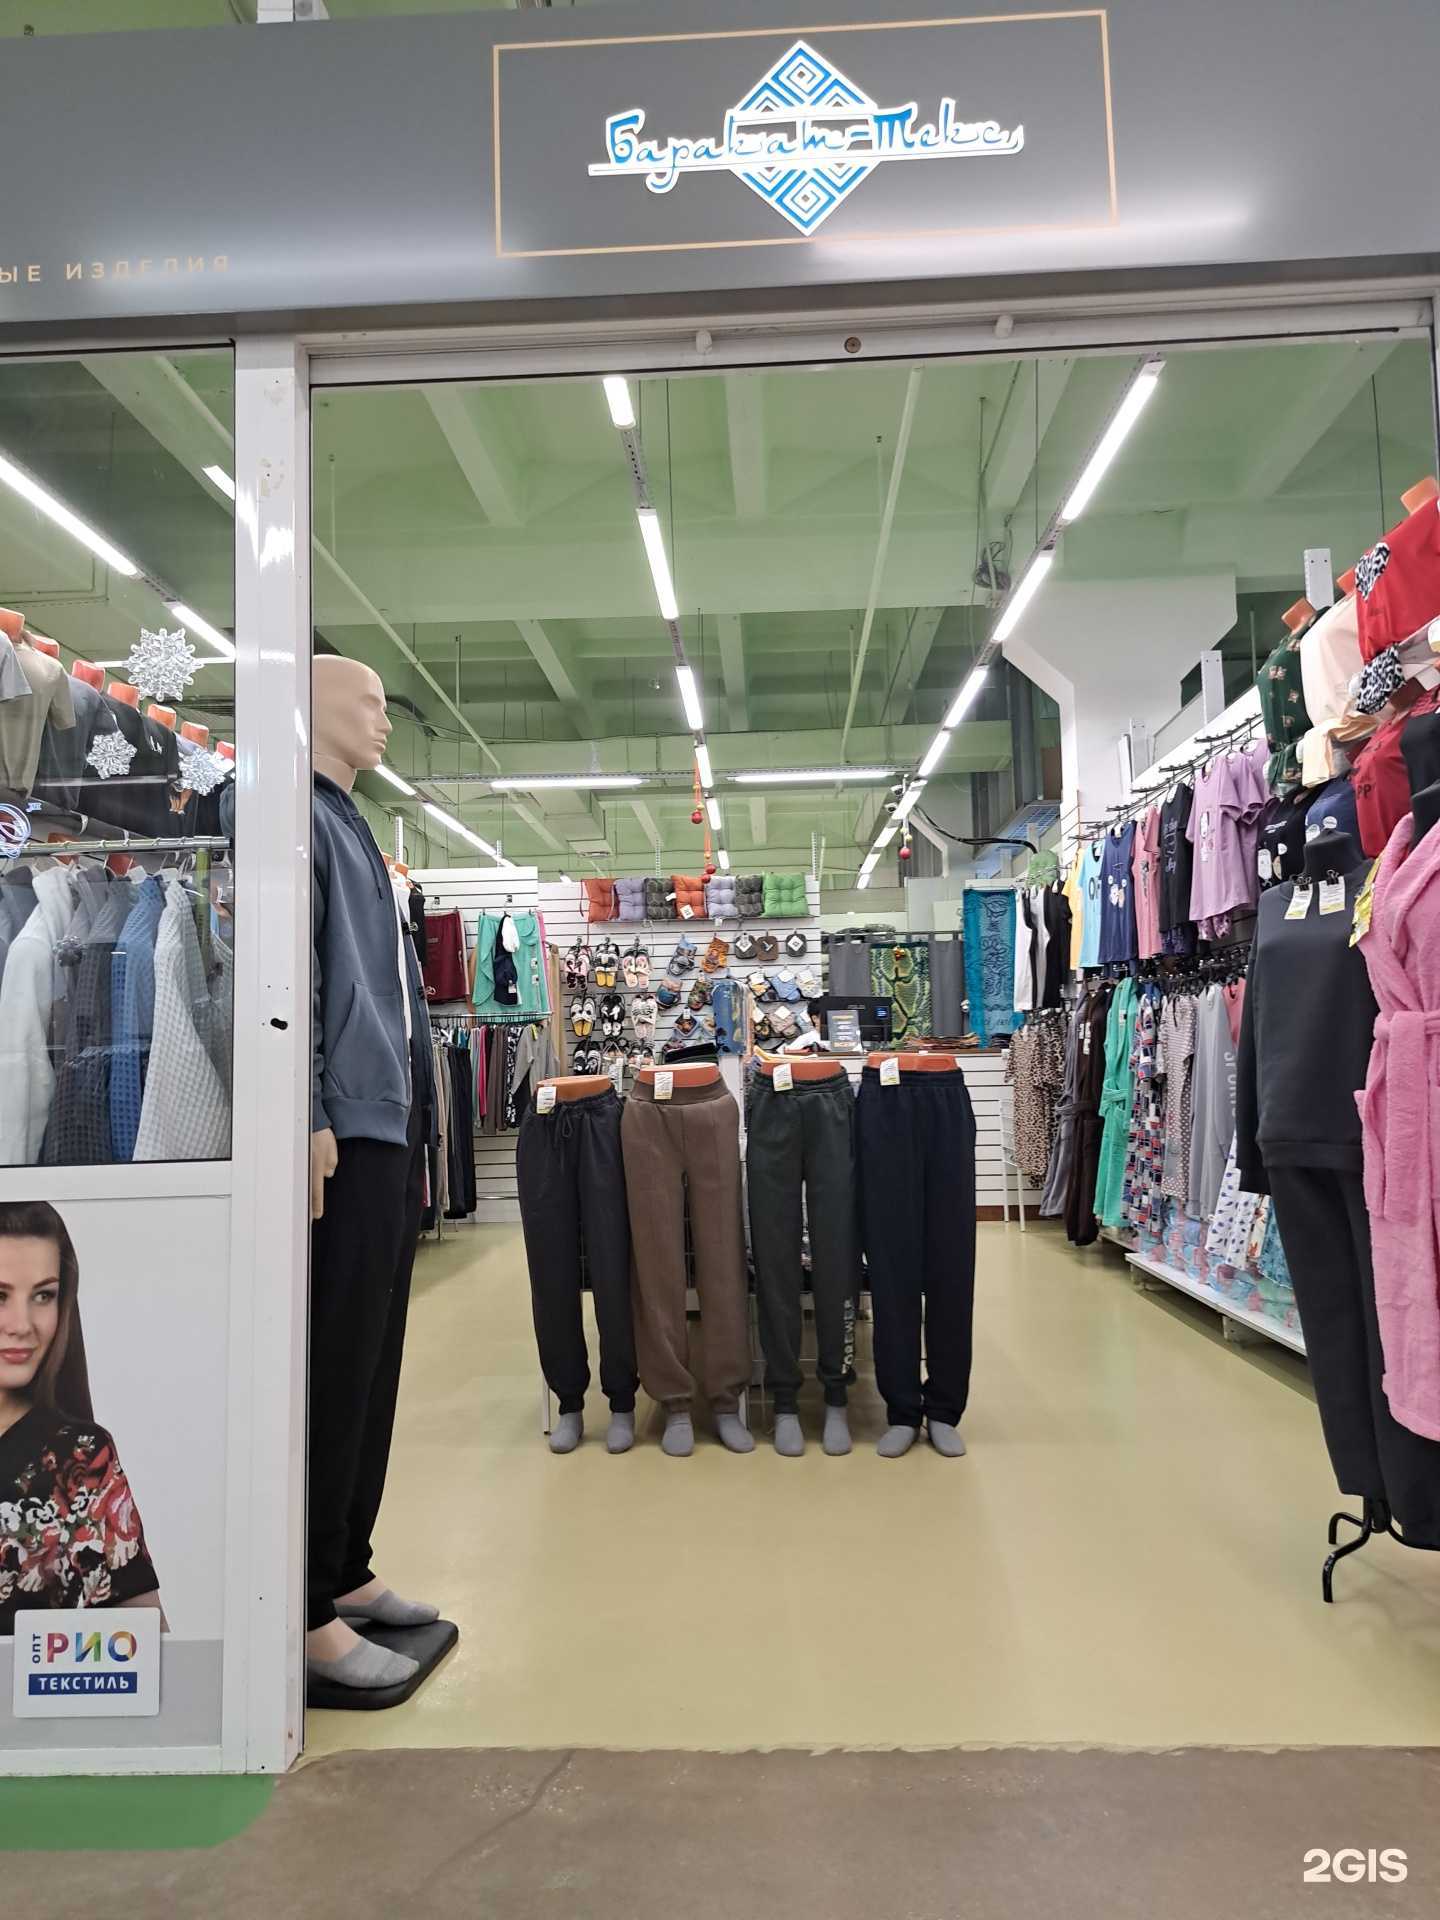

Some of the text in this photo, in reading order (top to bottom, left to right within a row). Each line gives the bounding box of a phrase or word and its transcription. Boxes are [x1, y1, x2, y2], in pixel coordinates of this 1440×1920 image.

[65, 255, 230, 281] ИЗДЕЛИЯ
[32, 1633, 42, 1664] ОПТ
[46, 1631, 138, 1664] РИО
[38, 1675, 130, 1691] ТЕКСТИЛЬ
